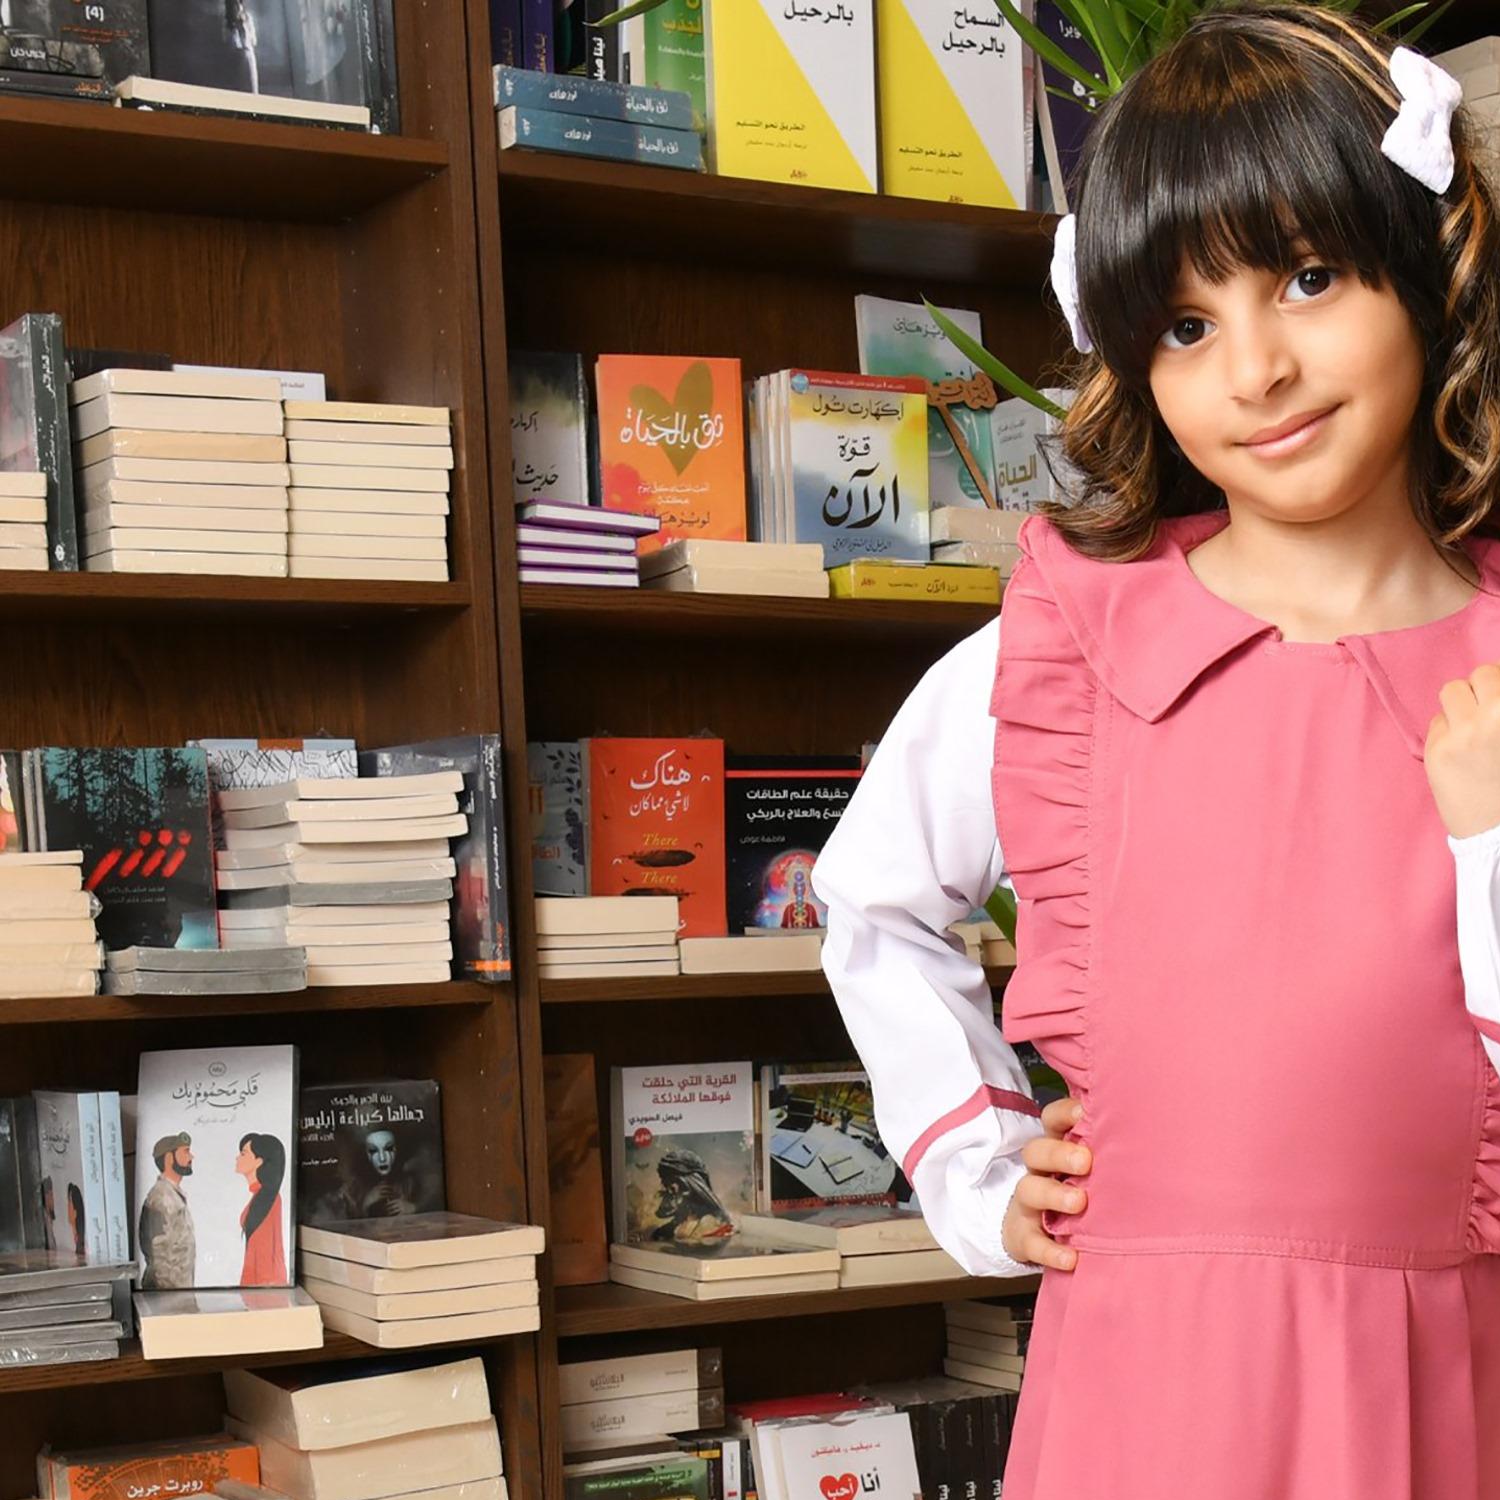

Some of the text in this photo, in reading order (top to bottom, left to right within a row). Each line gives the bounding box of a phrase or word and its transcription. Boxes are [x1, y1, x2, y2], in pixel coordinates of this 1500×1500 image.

[954, 7, 1005, 29] السماح
[942, 36, 1006, 58] بالرحيل
[822, 462, 900, 530] الآن
[746, 788, 850, 802] حقيقة علم الطاقات
[746, 808, 786, 823] بالريكي
[787, 808, 822, 821] والعلاج
[642, 832, 679, 846] There
[640, 871, 678, 885] There
[677, 1075, 703, 1091] التي
[706, 1073, 737, 1089] القرية
[652, 1092, 696, 1105] الملائكة
[127, 1478, 204, 1500] روبرت جرين
[826, 1466, 881, 1500] أنا أحب
